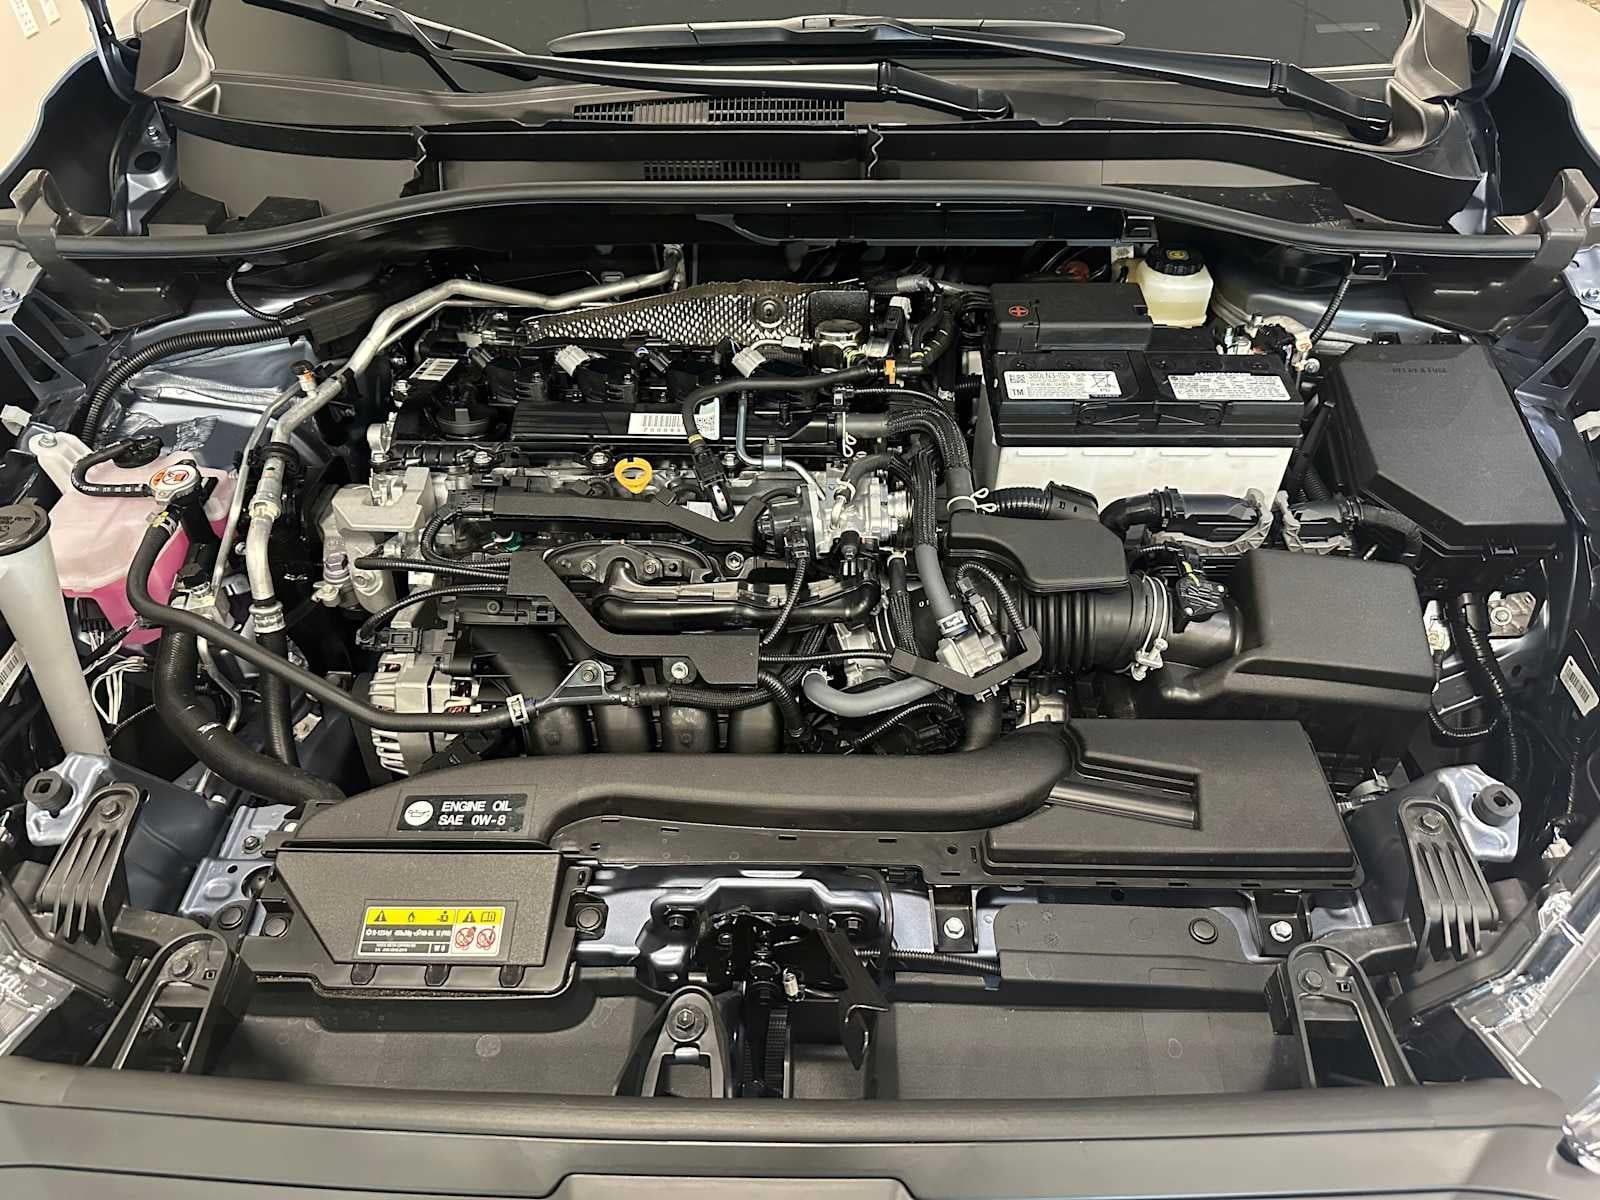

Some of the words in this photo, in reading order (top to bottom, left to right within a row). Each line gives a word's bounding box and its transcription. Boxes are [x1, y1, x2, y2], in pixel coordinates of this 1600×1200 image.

[441, 800, 487, 812] ENGINE
[492, 800, 513, 812] OIL
[437, 814, 465, 826] SAE
[470, 814, 507, 826] 0W-8
